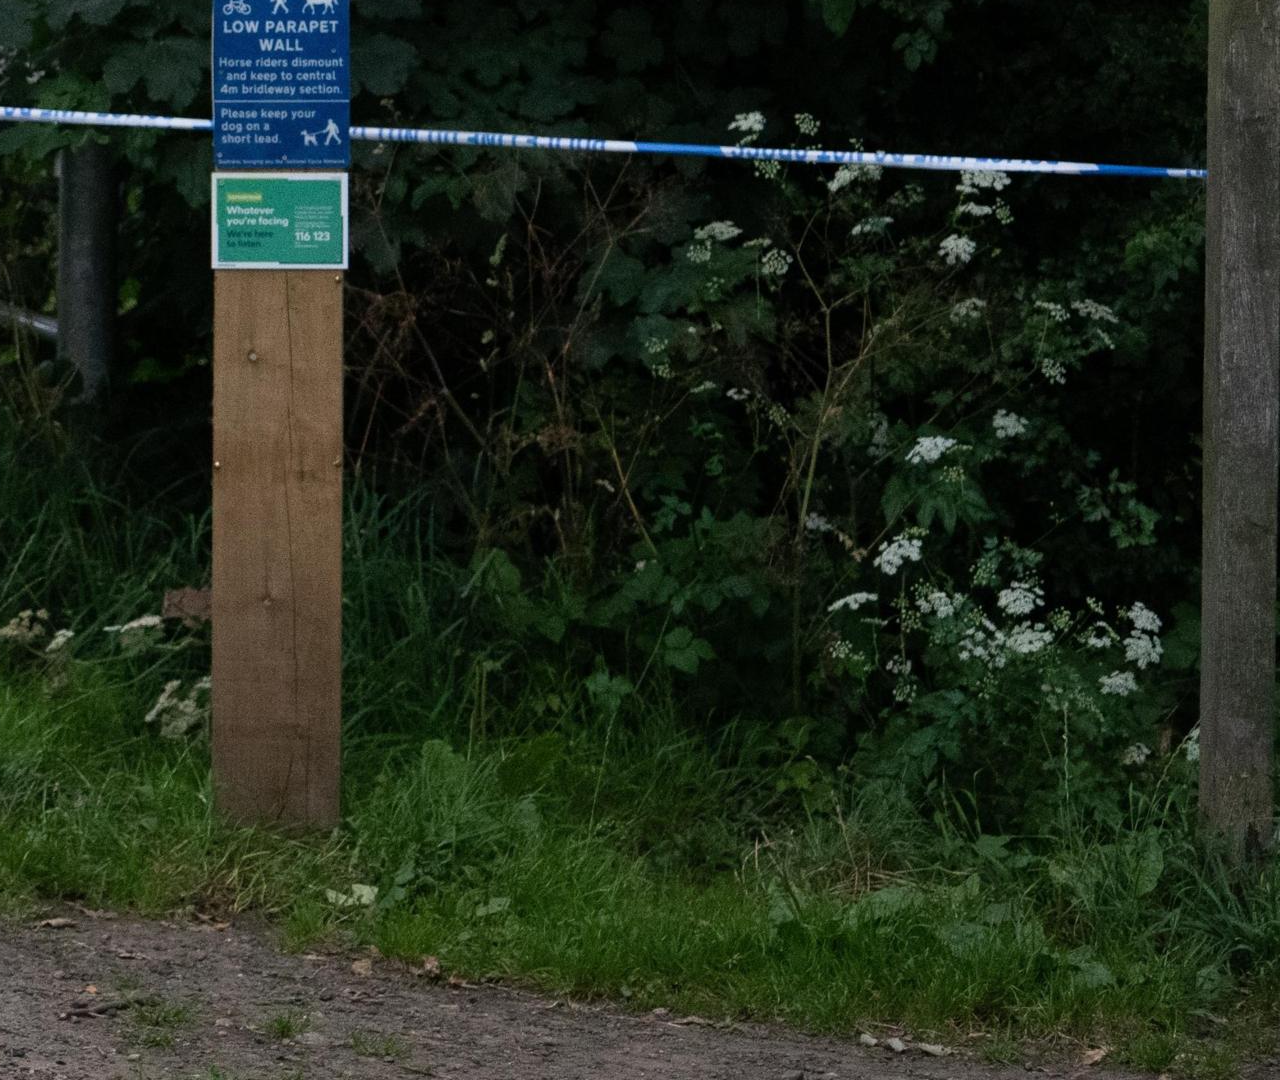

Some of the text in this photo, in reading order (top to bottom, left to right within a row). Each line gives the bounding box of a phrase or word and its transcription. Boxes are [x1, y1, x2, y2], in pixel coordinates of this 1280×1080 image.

[223, 20, 339, 33] LOW PARAPET
[259, 38, 303, 52] WALL
[219, 57, 343, 67] Horse riders dismount
[226, 71, 336, 82] and keep to central
[220, 84, 343, 96] 4m bridleway section.
[221, 108, 316, 120] Please keep your
[221, 121, 270, 133] dog on a
[221, 134, 251, 143] short
[226, 206, 274, 215] Whatever
[226, 217, 257, 227] you're
[258, 216, 289, 227] facing
[295, 231, 330, 241] 116 123
